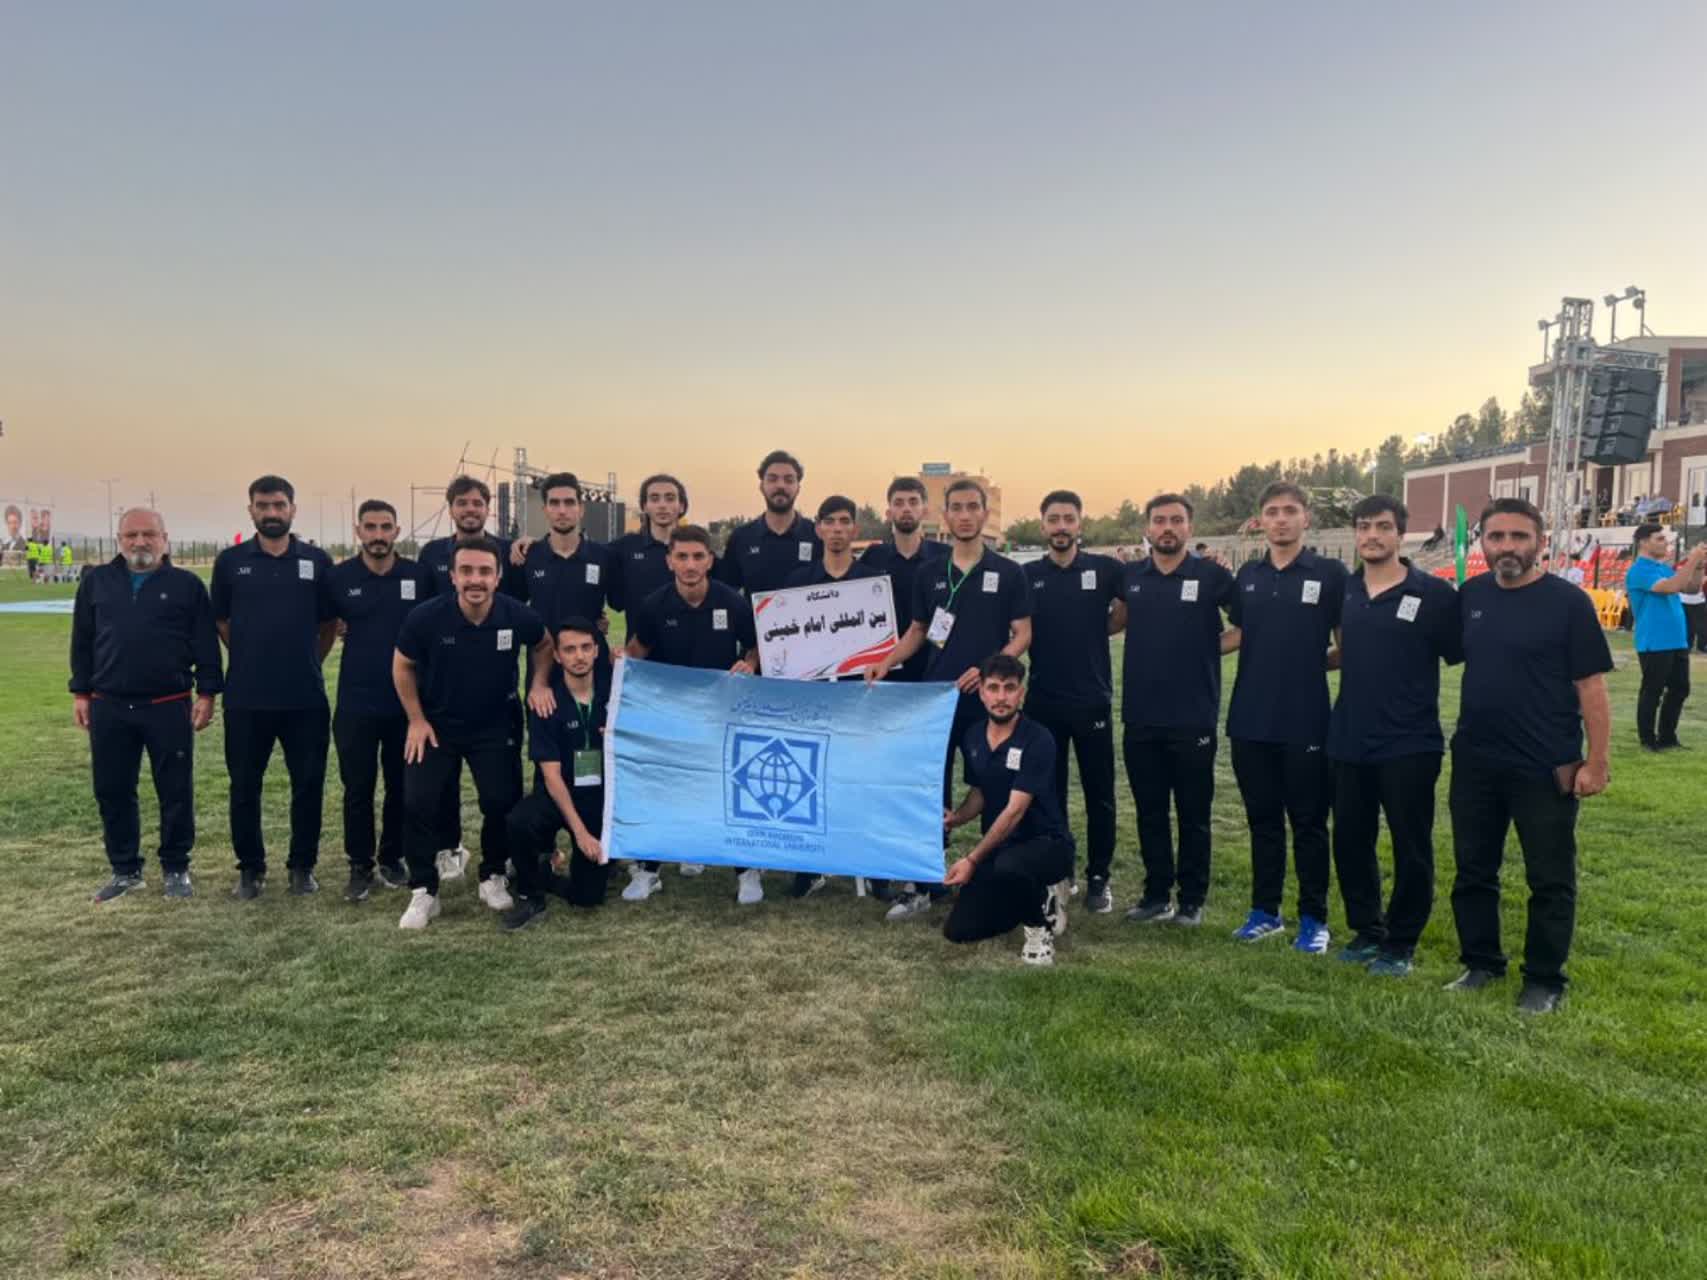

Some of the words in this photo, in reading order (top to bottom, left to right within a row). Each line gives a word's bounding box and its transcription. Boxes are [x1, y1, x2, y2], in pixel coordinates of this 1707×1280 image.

[806, 588, 840, 601] دانشگاه
[763, 618, 800, 642] خمینی
[803, 614, 826, 638] امام
[829, 609, 864, 633] المللی
[868, 610, 887, 628] بین
